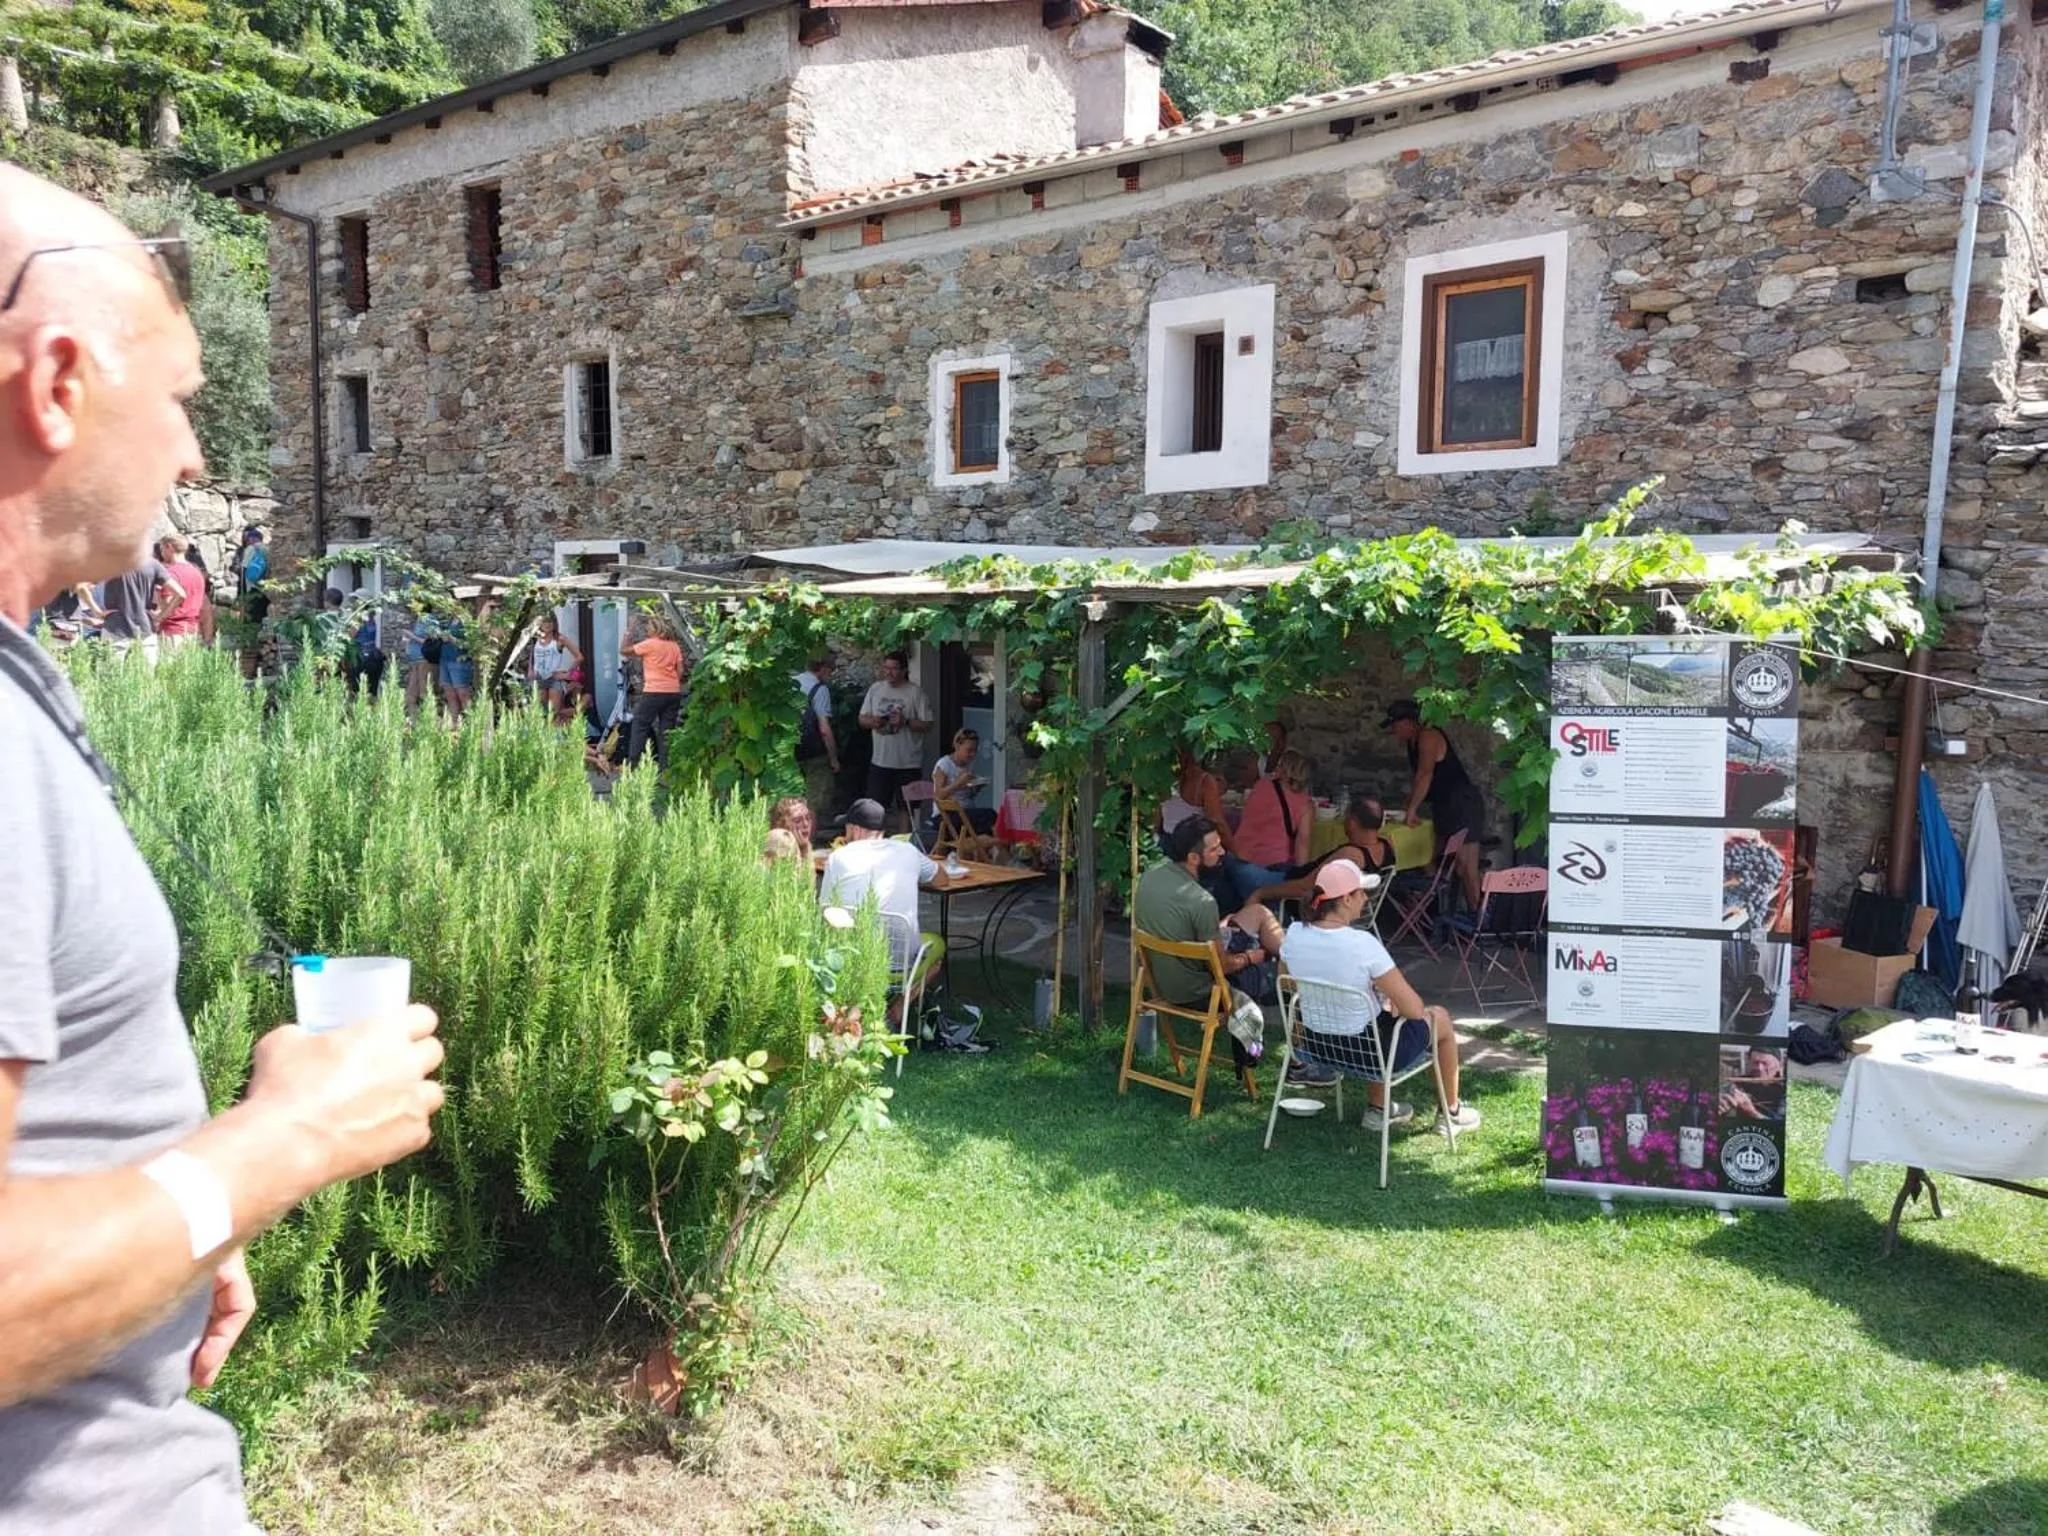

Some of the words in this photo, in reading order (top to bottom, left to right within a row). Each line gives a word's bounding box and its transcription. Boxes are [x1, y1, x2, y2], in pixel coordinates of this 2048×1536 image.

[1558, 707, 1592, 715] AZIENDA
[1593, 707, 1634, 715] AGRICOLA
[1635, 707, 1672, 716] GIACONE
[1673, 707, 1708, 716] DANIELE
[1727, 1125, 1775, 1140] CANTINA
